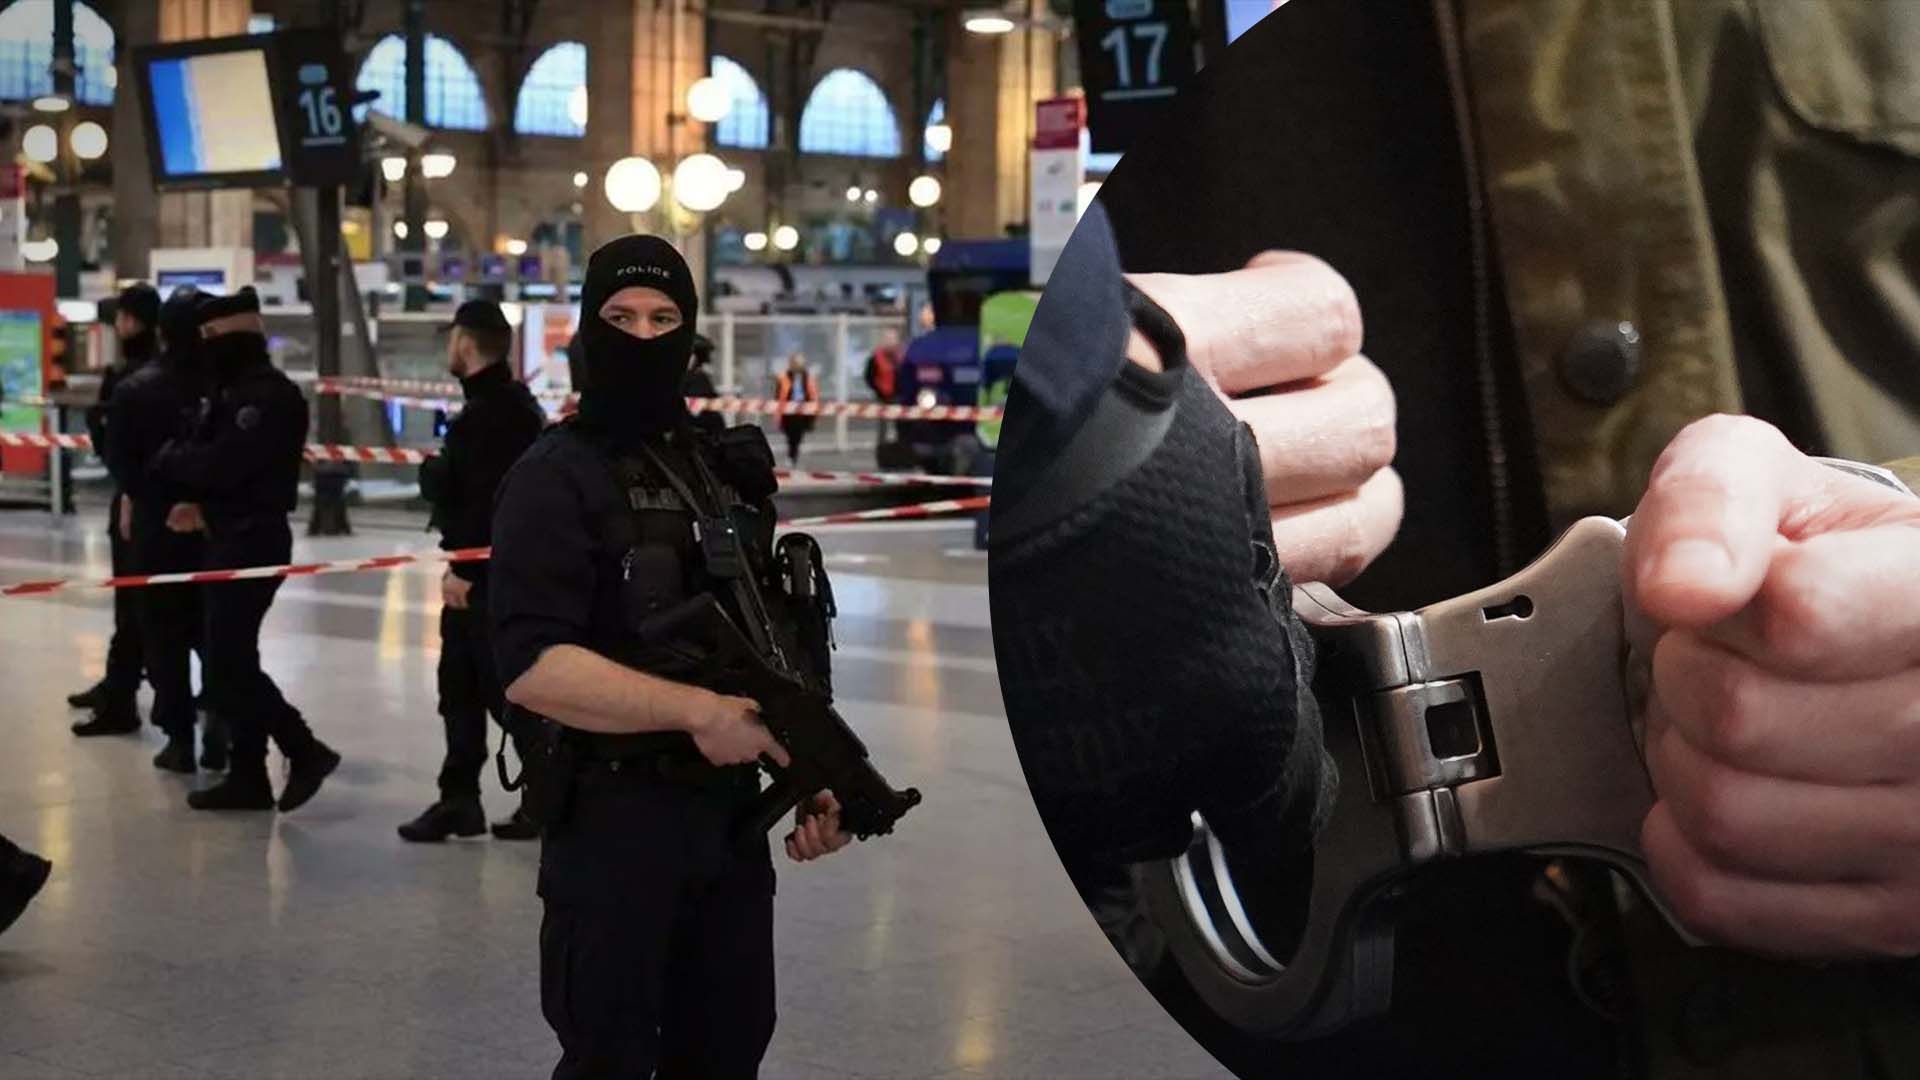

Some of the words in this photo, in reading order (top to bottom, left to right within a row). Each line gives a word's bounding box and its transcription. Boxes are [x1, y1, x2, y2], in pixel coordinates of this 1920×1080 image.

[1101, 23, 1168, 87] 17
[299, 86, 342, 136] 16
[617, 265, 671, 278] POLICE
